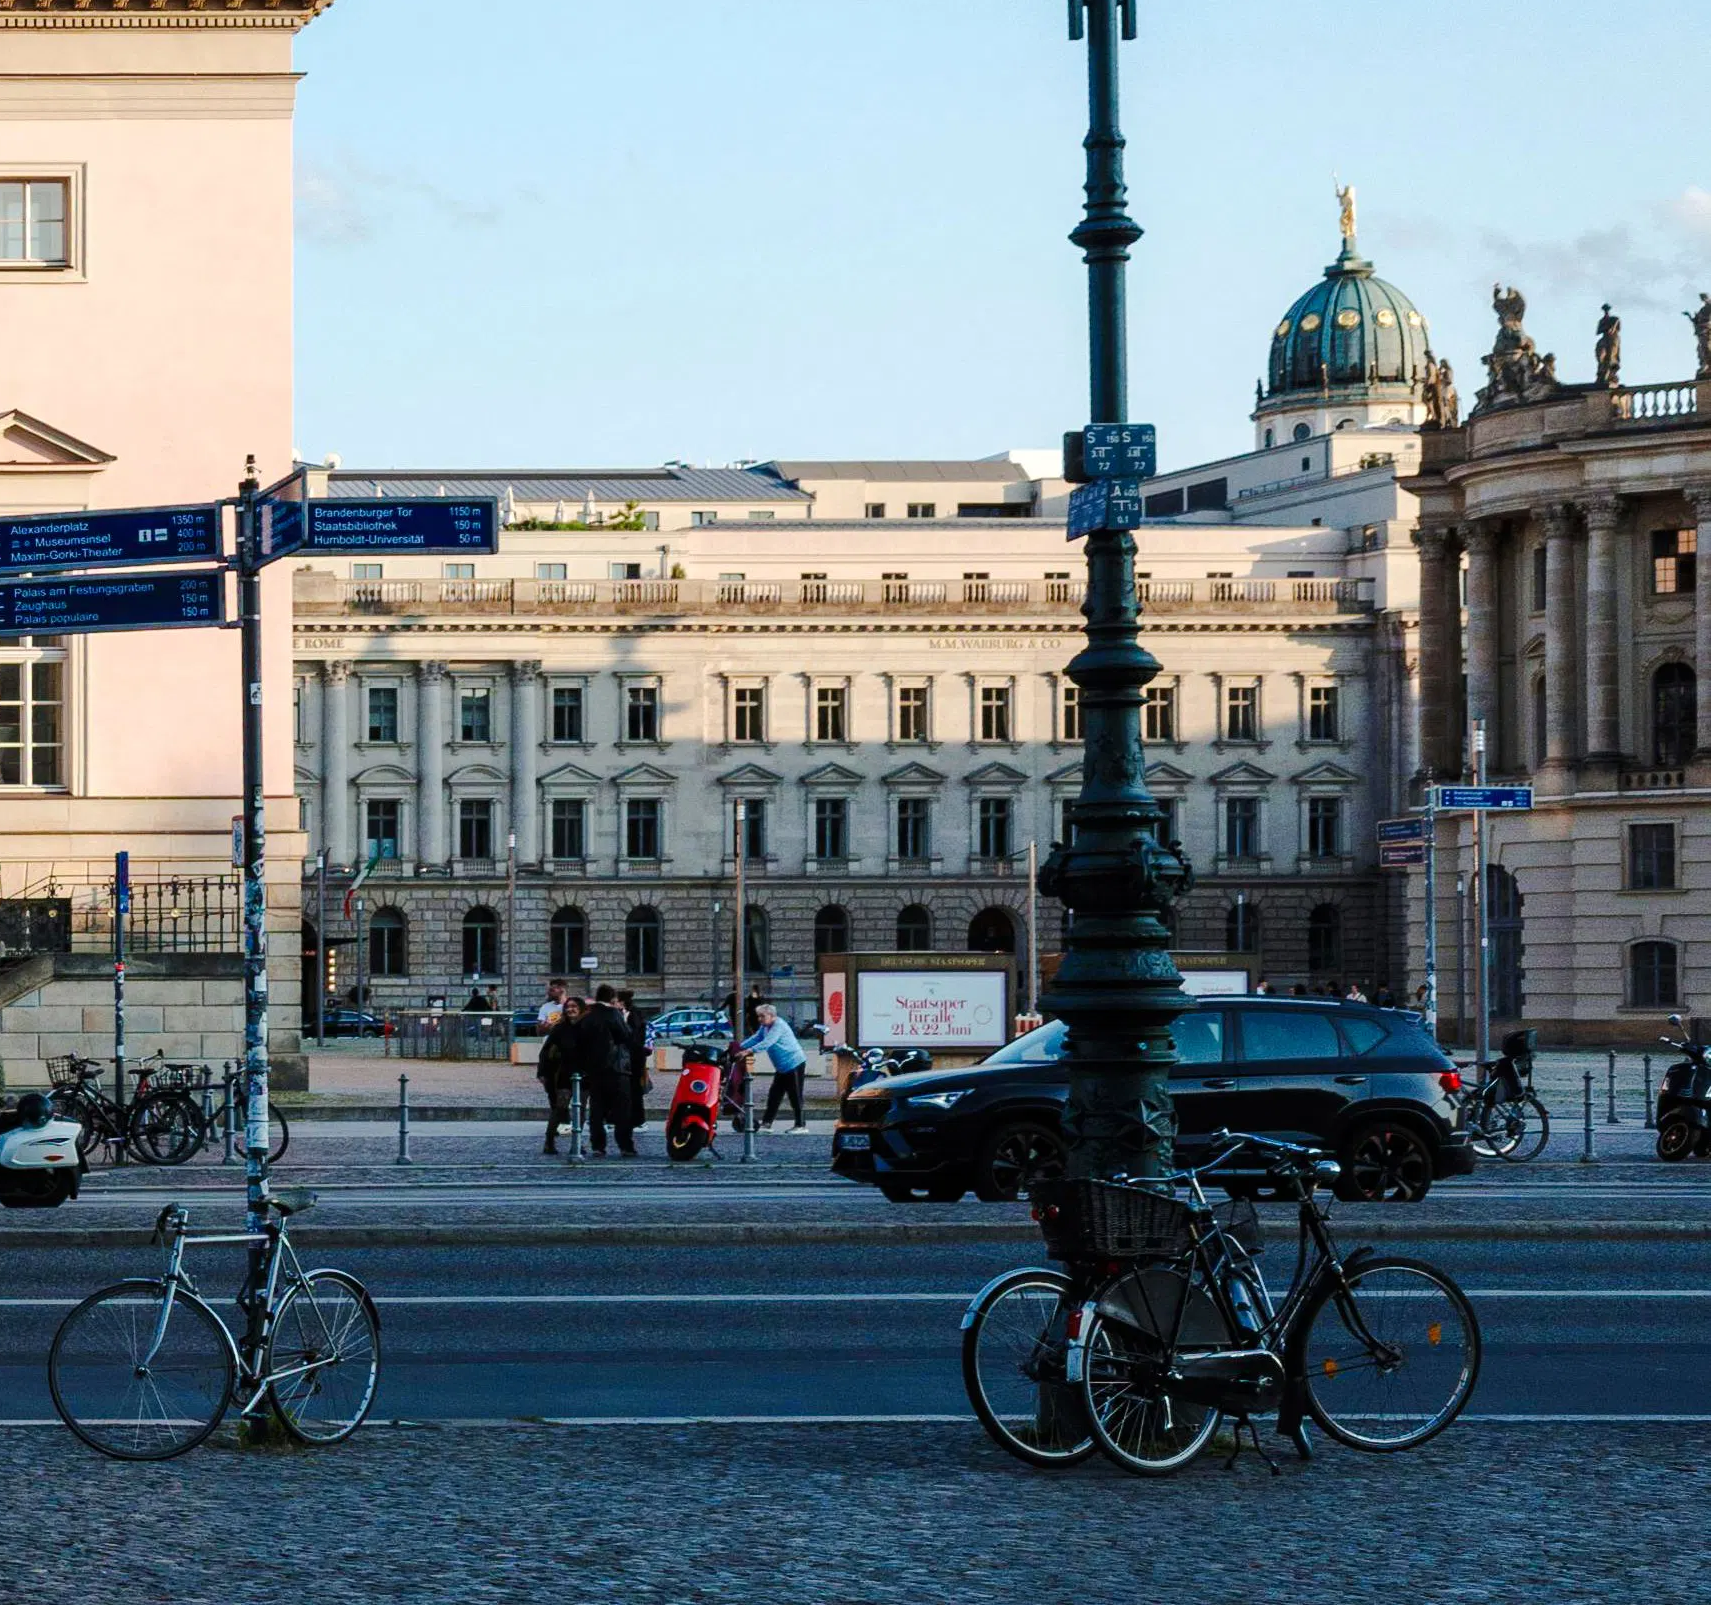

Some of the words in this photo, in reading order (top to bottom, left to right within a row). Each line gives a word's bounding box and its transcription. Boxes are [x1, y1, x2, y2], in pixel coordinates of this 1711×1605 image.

[315, 507, 393, 519] Brandenburger
[397, 507, 413, 517] Tor
[449, 507, 470, 516] 1150
[10, 522, 89, 536] Alexanderplatz
[172, 514, 194, 525] 1350
[196, 516, 205, 524] m
[314, 521, 398, 531] Staatsbibliothek
[454, 521, 470, 530] 150
[35, 534, 111, 547] Museumsinsel
[314, 534, 425, 545] Humboldt-Universität
[459, 534, 470, 543] 50
[11, 548, 123, 563] Maxim-Gorki-Theater
[14, 587, 47, 598] Palais
[69, 582, 154, 597] Festungsgraben
[15, 600, 67, 613] Zeughaus
[15, 614, 47, 624] Palais
[50, 612, 99, 625] populaire
[895, 996, 968, 1012] Staatsoper
[931, 1009, 956, 1023] alle
[891, 1024, 908, 1036] 21.
[909, 1024, 920, 1036] &
[922, 1024, 943, 1036] 22.
[946, 1023, 972, 1036] Juni
